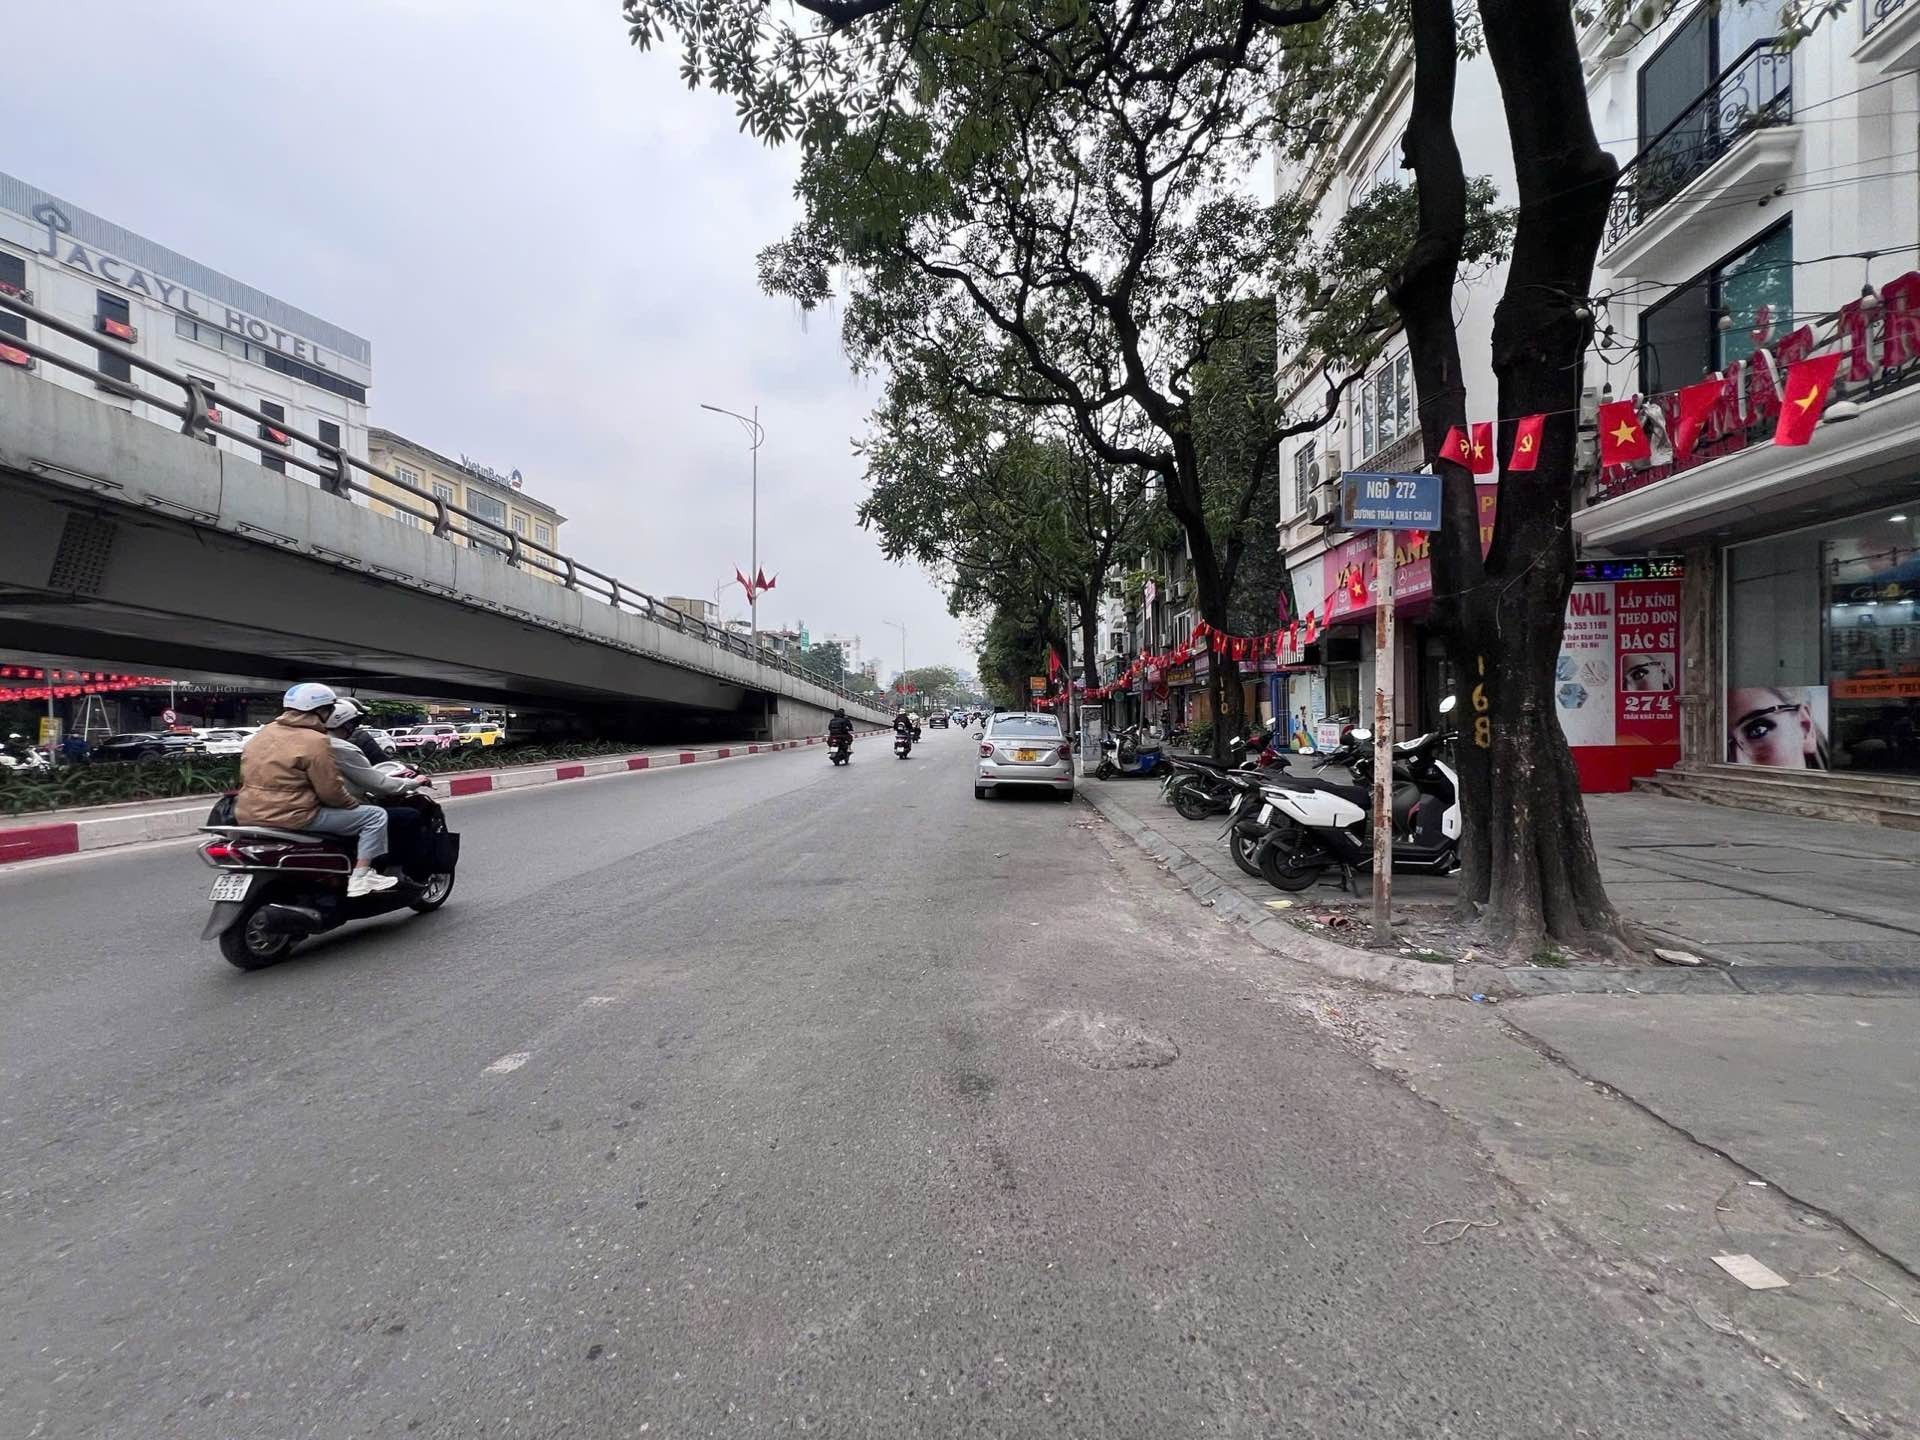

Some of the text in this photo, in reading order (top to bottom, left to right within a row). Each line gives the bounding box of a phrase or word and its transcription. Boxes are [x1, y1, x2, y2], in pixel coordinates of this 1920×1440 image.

[38, 204, 326, 367] JACAYL HOTEL
[460, 453, 512, 487] VietinBank
[1366, 477, 1417, 499] NGÕ 272
[1569, 592, 1611, 617] NAIL
[1620, 589, 1676, 609] LẮP KÍNH
[1618, 609, 1677, 625] THEO ĐƠN
[1620, 627, 1676, 650] BÁC SĨ
[216, 685, 249, 694] HOTEL
[1472, 655, 1490, 749] 168
[1625, 695, 1672, 711] 274
